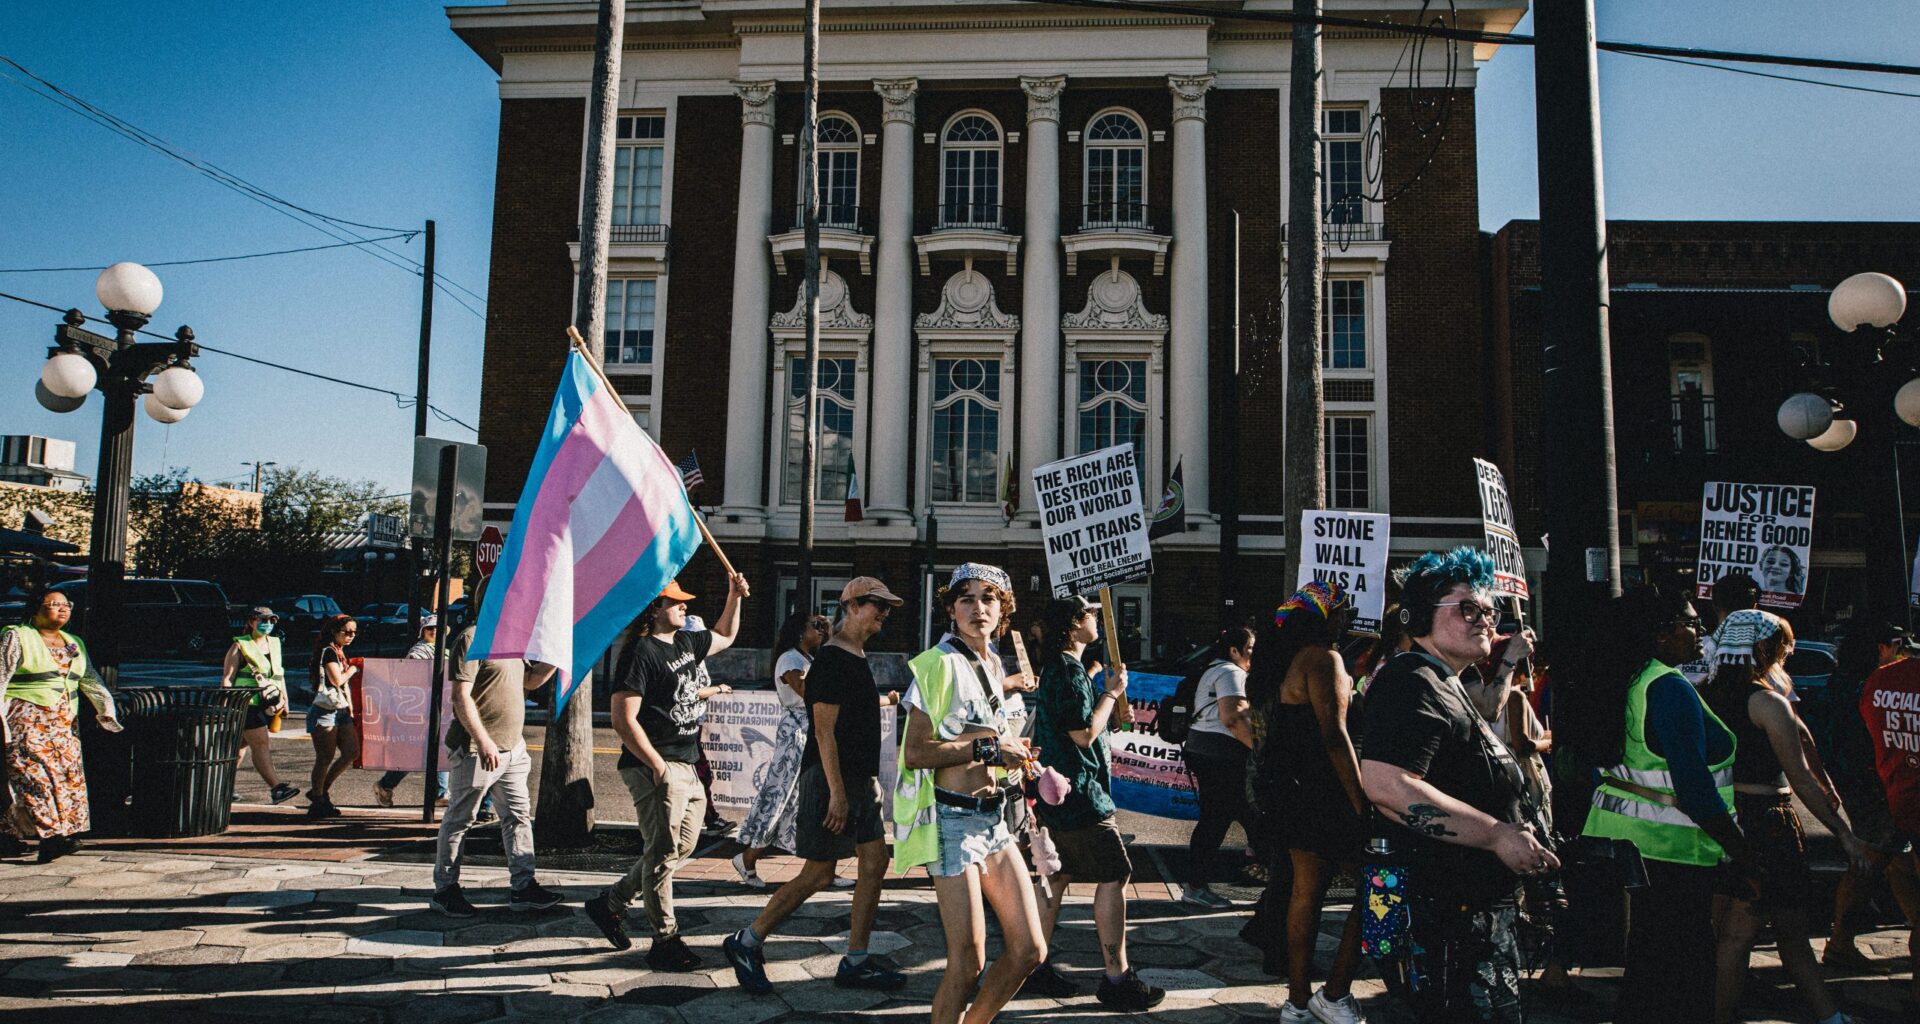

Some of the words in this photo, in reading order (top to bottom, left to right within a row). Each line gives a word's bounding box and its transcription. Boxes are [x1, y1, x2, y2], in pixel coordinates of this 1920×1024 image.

[1034, 470, 1063, 492] THE
[1066, 460, 1101, 484] RICH
[1106, 450, 1134, 473] ARE
[1041, 469, 1134, 510] DESTROYING
[1706, 483, 1813, 518] JUSTICE
[1046, 505, 1076, 527] OUR
[1079, 488, 1132, 517] WORLD
[1738, 513, 1777, 524] FOR
[1048, 528, 1081, 555] NOT
[1086, 513, 1142, 543] TRANS
[1314, 516, 1374, 541] STONE
[1703, 519, 1757, 543] RENEE
[1761, 524, 1811, 547] GOOD
[478, 542, 503, 564] STOP
[1068, 537, 1129, 569] YOUTH!
[1315, 543, 1366, 567] WALL
[1701, 541, 1758, 565] KILLED
[1060, 570, 1081, 583] FIGHT
[1082, 564, 1097, 577] THE
[1097, 559, 1116, 573] REAL
[1117, 552, 1143, 566] ENEMY
[1075, 577, 1093, 589] Party
[1093, 574, 1103, 583] for
[1103, 566, 1134, 581] Socialism
[1134, 562, 1146, 572] and
[1699, 562, 1722, 583] BY
[1313, 568, 1350, 590] WAS
[1354, 573, 1367, 592] A
[1056, 588, 1072, 600] PSL
[1872, 689, 1920, 712] SOCIAL
[1885, 710, 1900, 731] IS
[1903, 712, 1920, 733] TH
[1882, 730, 1920, 753] FUTU
